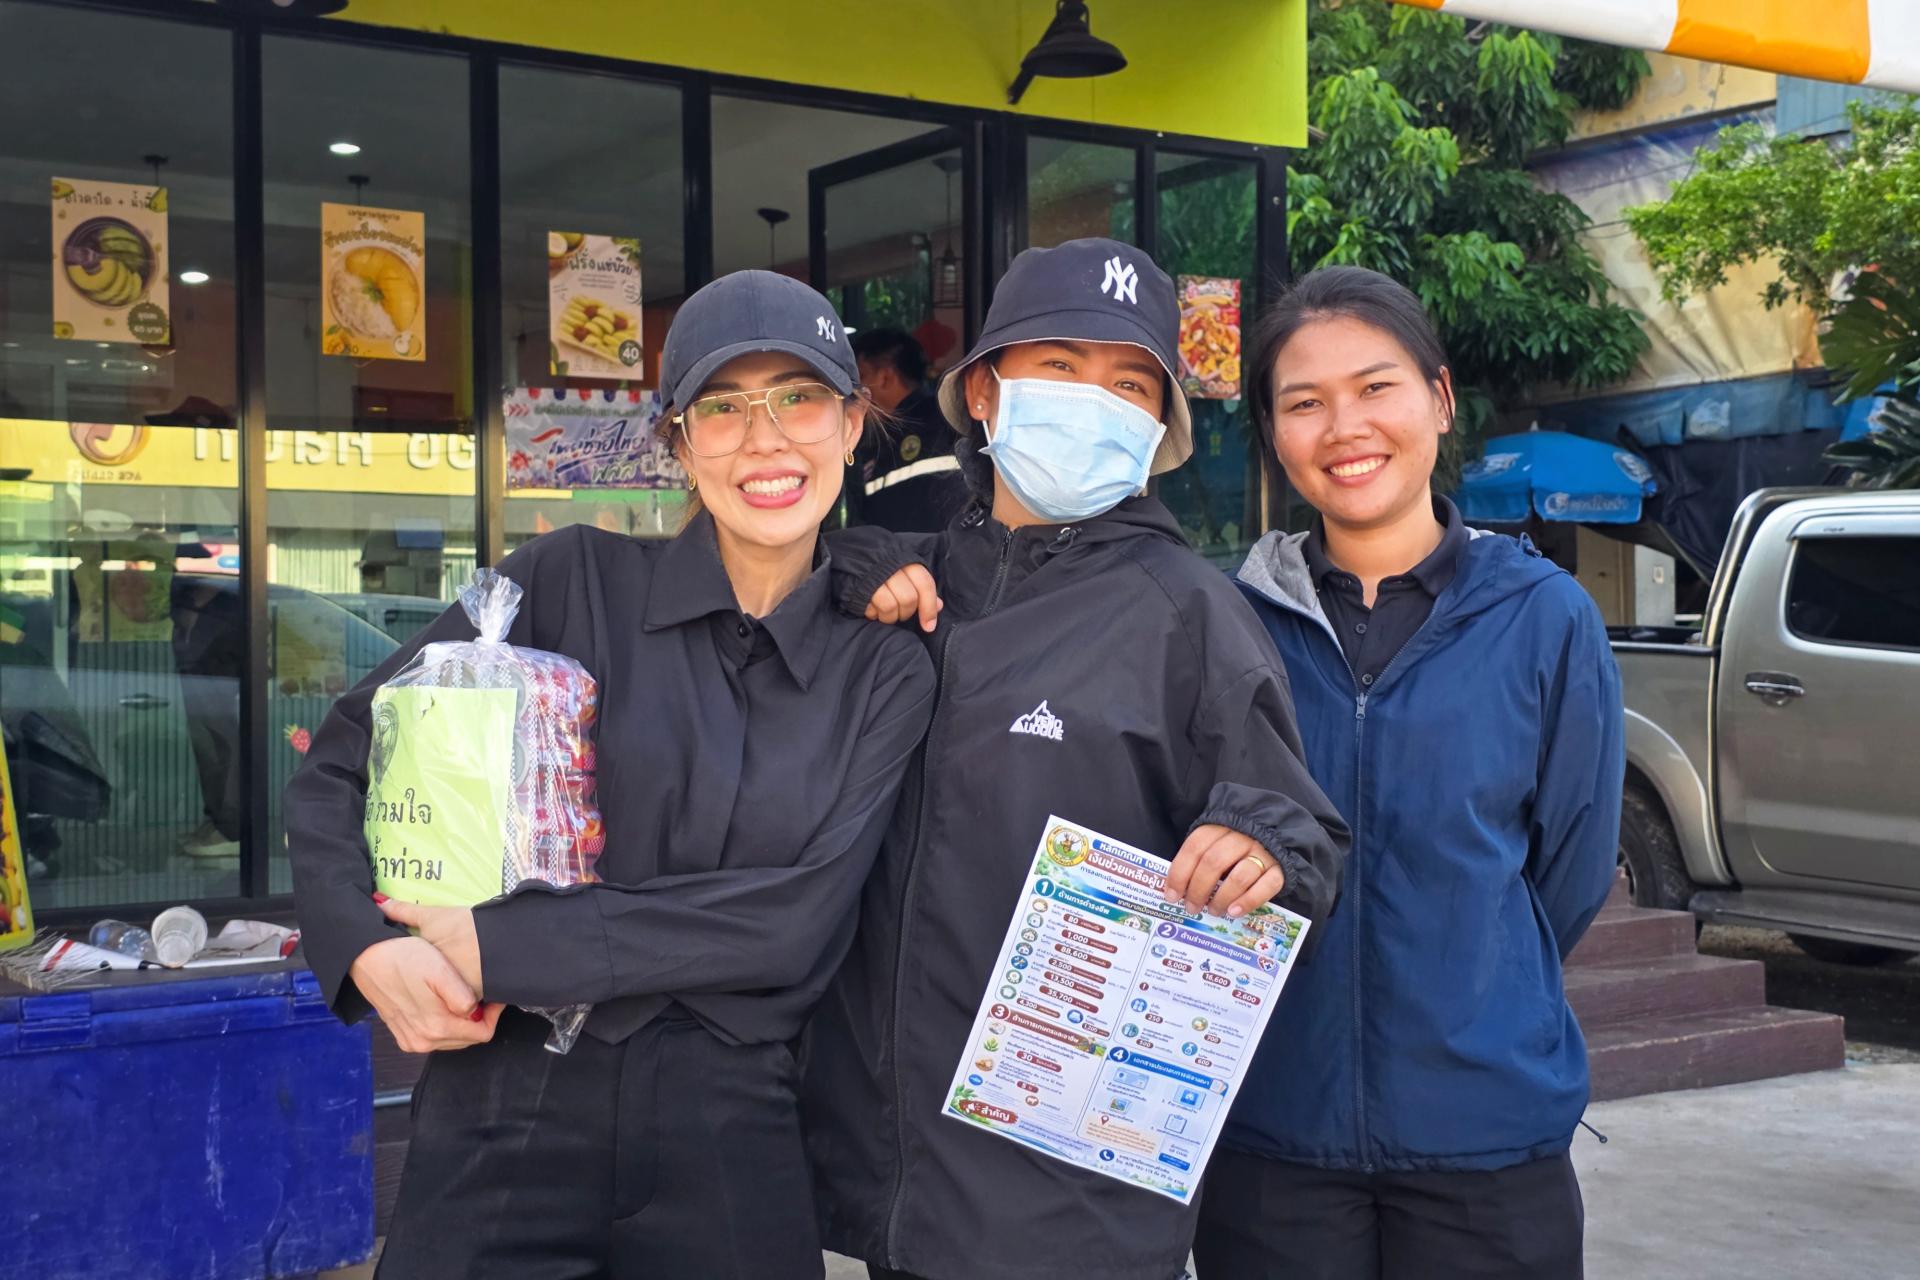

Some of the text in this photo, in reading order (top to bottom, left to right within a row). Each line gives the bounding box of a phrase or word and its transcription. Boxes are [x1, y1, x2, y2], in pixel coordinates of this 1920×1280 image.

[1101, 256, 1138, 304] NY
[622, 347, 639, 359] 40
[1087, 850, 1166, 891] เงินช่วยเหลือผู้ป
[1038, 880, 1049, 894] 1
[1160, 923, 1172, 936] 2
[994, 1004, 1005, 1017] 3
[1112, 1047, 1124, 1060] 4
